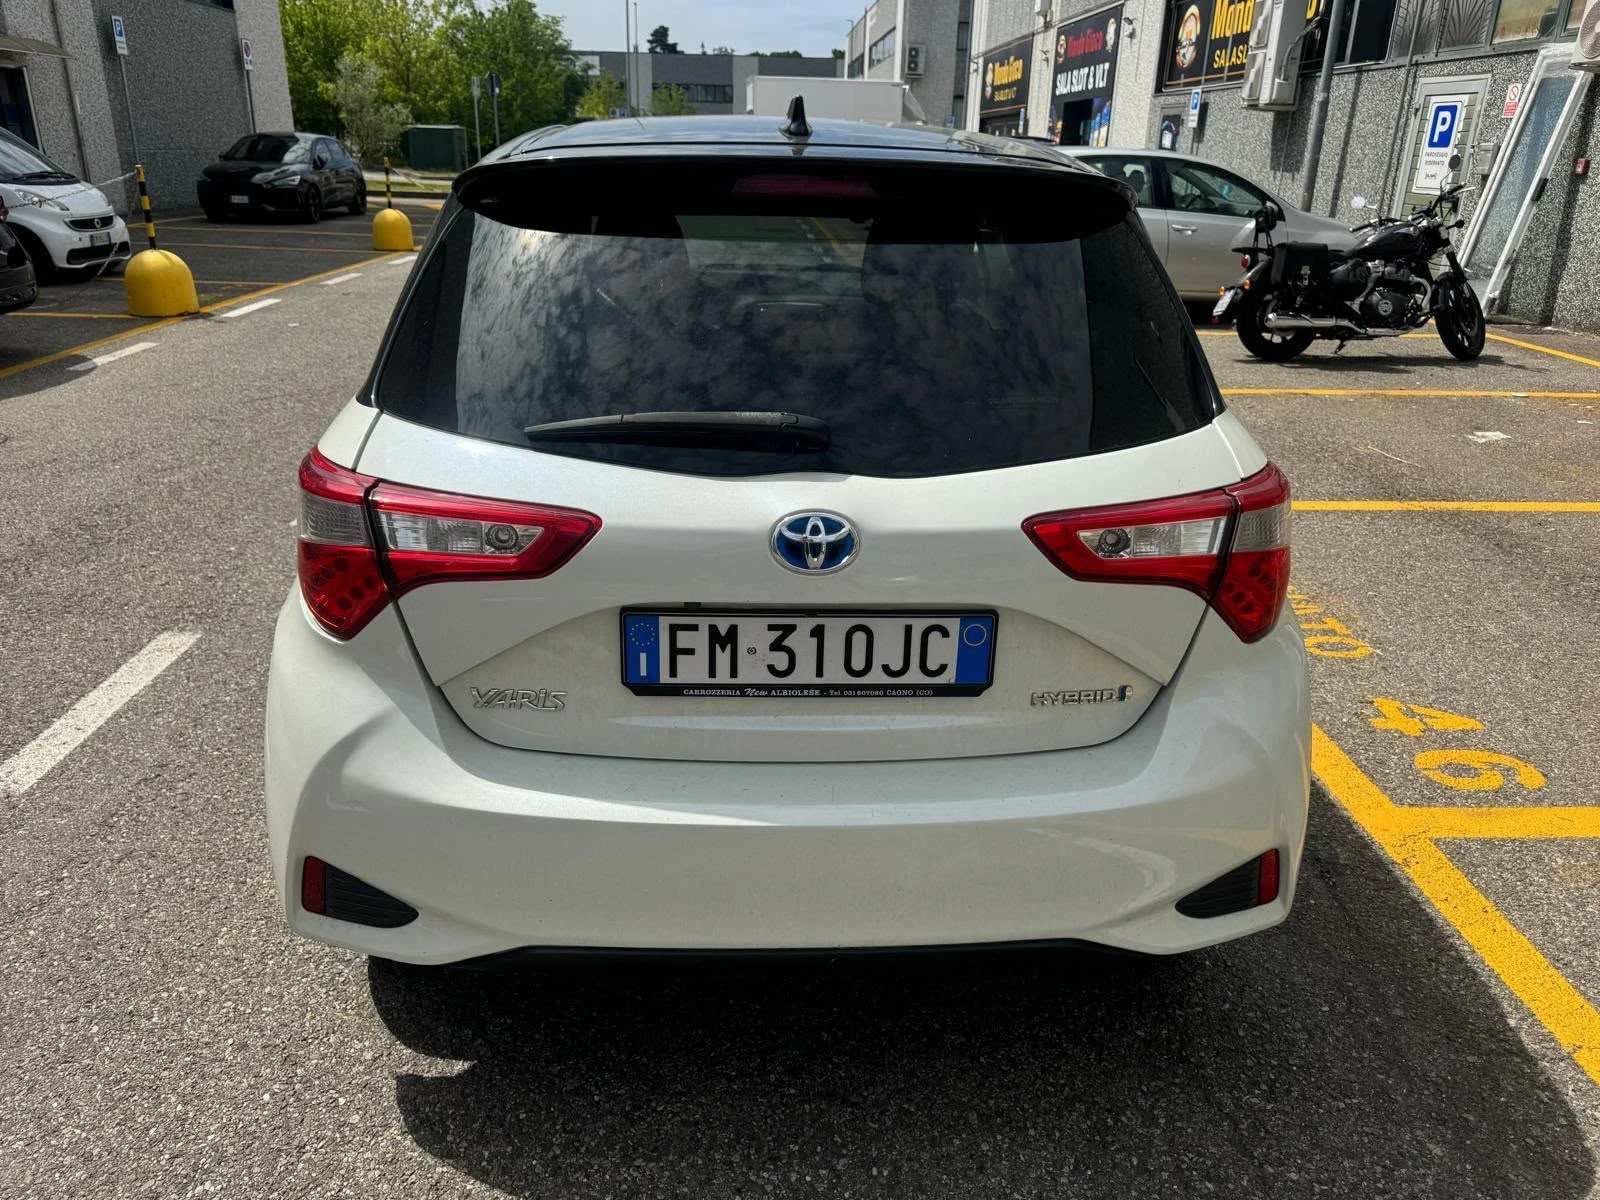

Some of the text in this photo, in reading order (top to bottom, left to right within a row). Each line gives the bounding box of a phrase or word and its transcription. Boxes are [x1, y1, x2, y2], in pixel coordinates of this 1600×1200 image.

[1056, 62, 1110, 96] SALA SLOT & VLT
[1432, 110, 1452, 143] P
[668, 623, 951, 679] FM 310JC
[683, 688, 741, 696] CARROZZERIA
[744, 687, 768, 697] New
[770, 689, 821, 697] ALBIOLESE
[886, 689, 914, 697] CAGNO
[916, 689, 934, 697] (CO)
[1030, 688, 1117, 707] HYBRID
